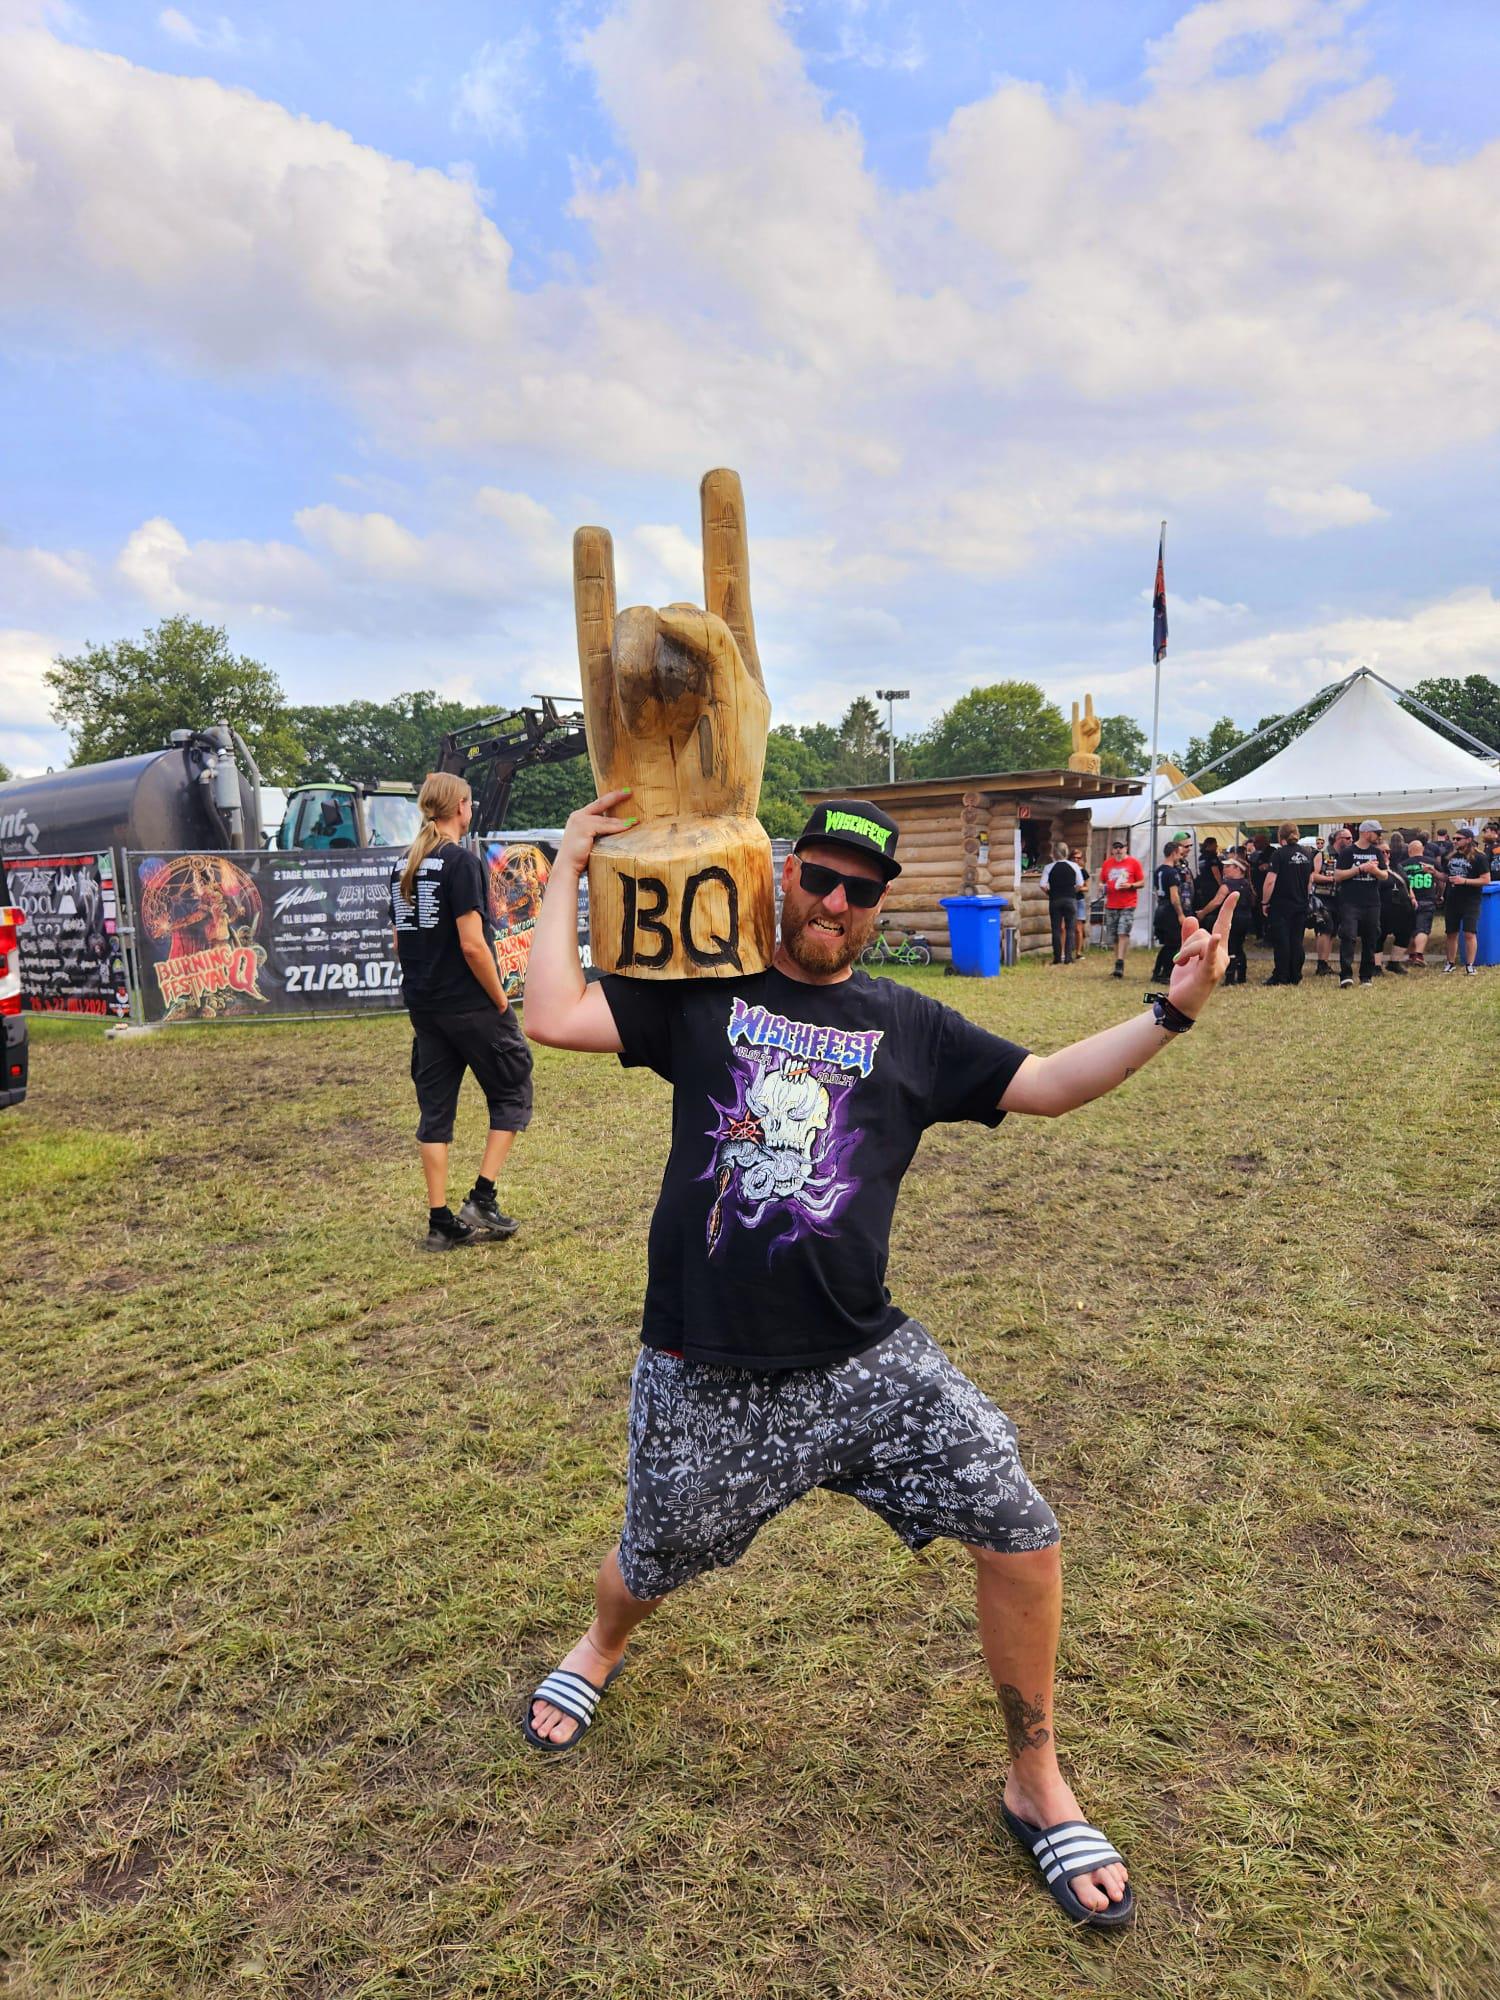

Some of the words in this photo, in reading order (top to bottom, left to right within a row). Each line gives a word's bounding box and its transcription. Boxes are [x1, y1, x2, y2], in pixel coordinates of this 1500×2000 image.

[0, 808, 28, 839] nt
[825, 810, 892, 852] WISCHFEST
[274, 870, 280, 881] 2
[282, 869, 302, 880] TAGE
[303, 868, 330, 880] METAL
[331, 868, 339, 878] &
[340, 866, 378, 878] CAMPING
[380, 866, 389, 876] IN
[616, 866, 743, 975] BQ
[154, 943, 232, 989] BURNING
[229, 946, 270, 1003] Q
[160, 967, 230, 1009] FESTIVAL
[727, 997, 884, 1078] WISCHFEST
